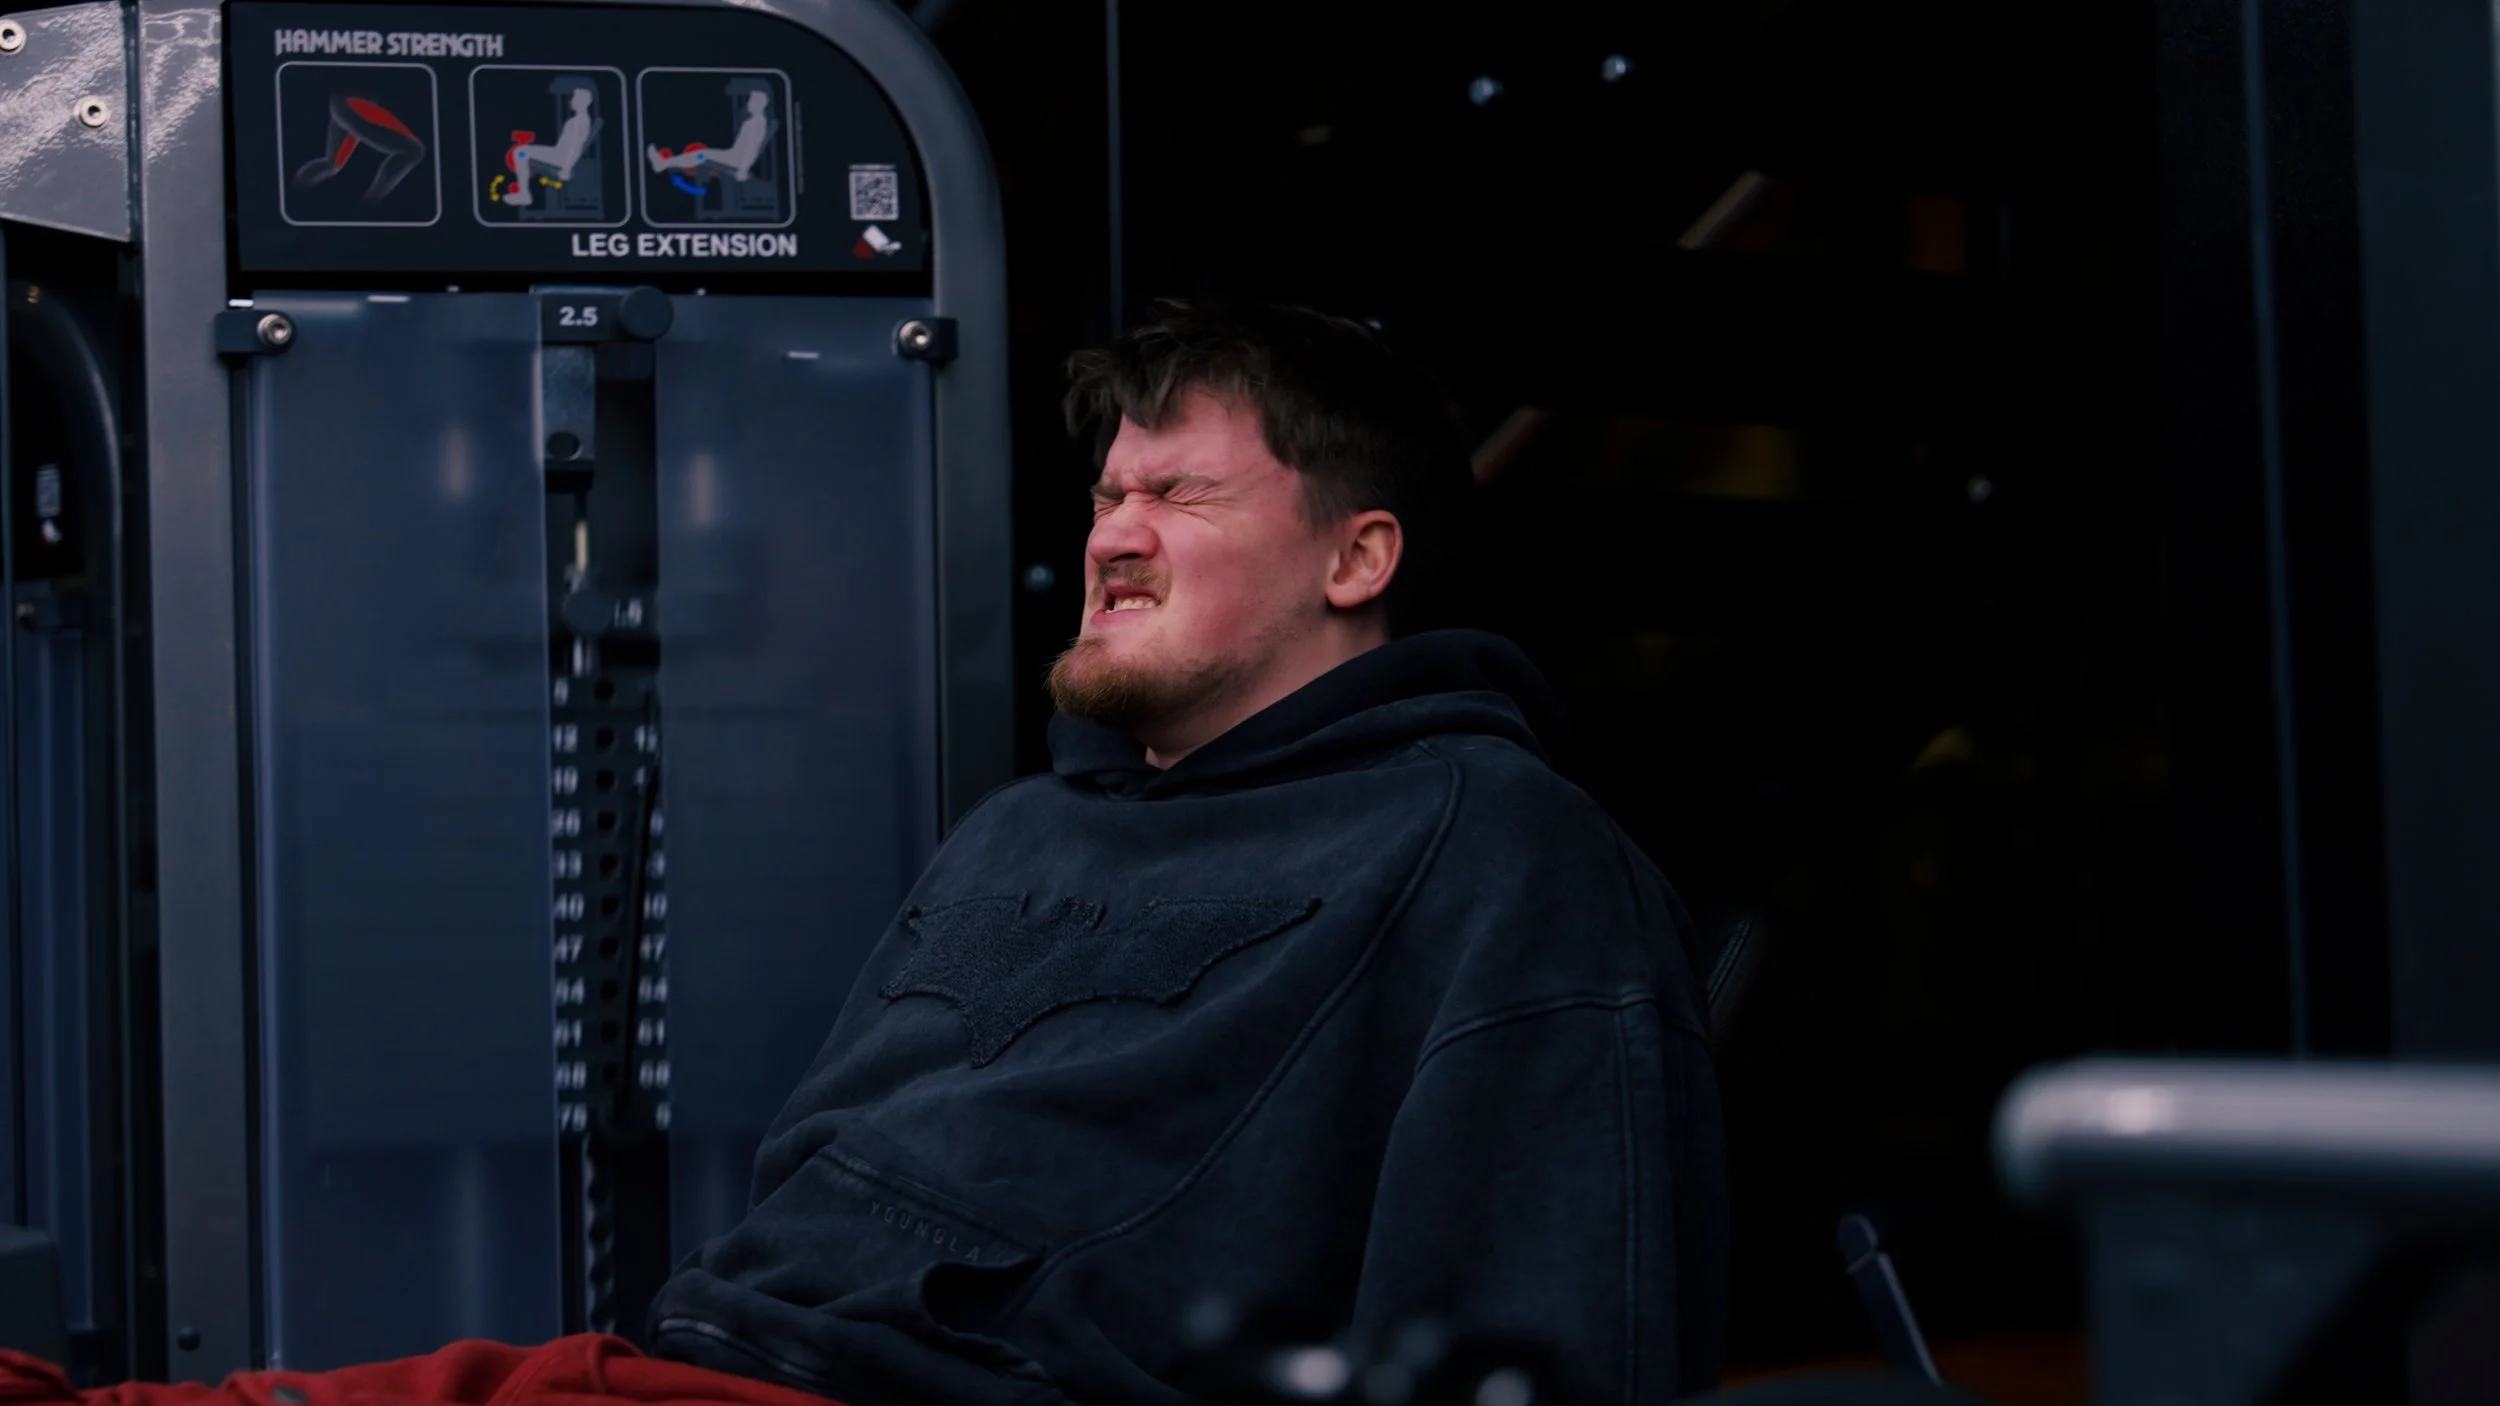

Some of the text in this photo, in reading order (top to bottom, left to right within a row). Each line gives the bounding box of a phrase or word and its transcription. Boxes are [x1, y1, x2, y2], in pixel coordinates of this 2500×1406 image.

[275, 29, 504, 58] HAMMER STRENGTH
[571, 233, 798, 257] LEG EXTENSION
[559, 305, 598, 327] 2.5
